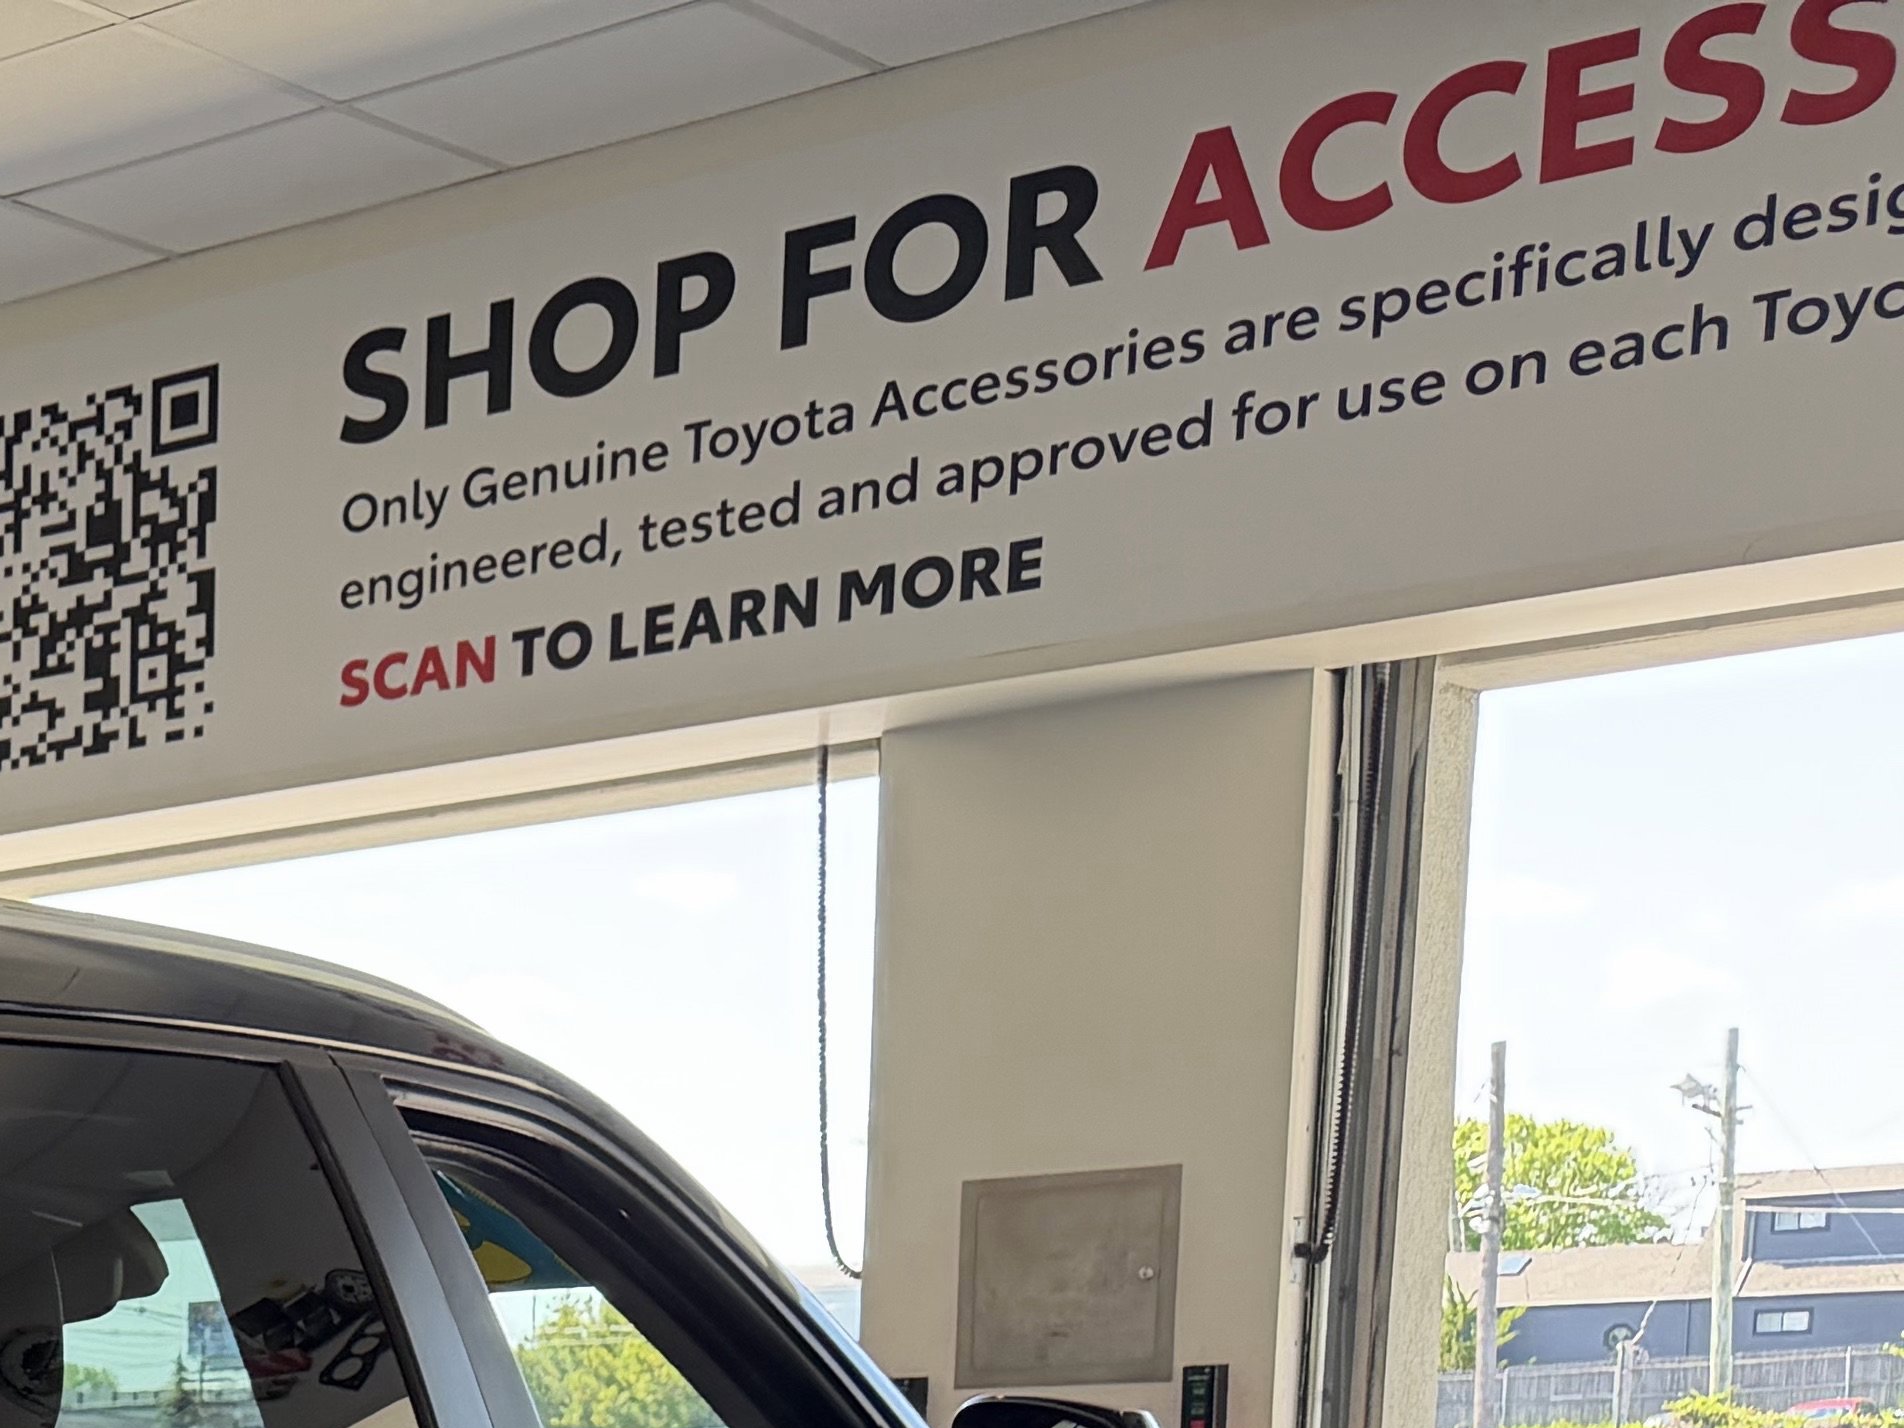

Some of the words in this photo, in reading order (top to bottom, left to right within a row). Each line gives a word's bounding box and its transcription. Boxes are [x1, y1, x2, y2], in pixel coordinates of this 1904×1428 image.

[339, 251, 736, 445] SHOP
[780, 164, 1103, 351] FOR
[1144, 0, 1896, 270] ACCESS
[342, 479, 449, 533] Only
[462, 440, 669, 508] Genuine
[684, 400, 854, 465] Toyota
[871, 328, 1205, 427] Accessories
[1224, 305, 1320, 355] are
[1338, 215, 1715, 339] specifically
[340, 517, 622, 610] engineered,
[639, 479, 801, 552] tested
[818, 456, 919, 519] and
[936, 398, 1213, 504] approved
[1232, 390, 1320, 441] for
[1337, 370, 1446, 421] use
[1465, 350, 1547, 396] on
[1569, 303, 1728, 377] each
[340, 635, 496, 707] SCAN
[512, 620, 593, 677] TO
[609, 576, 818, 662] LEARN
[838, 536, 1043, 623] MORE
